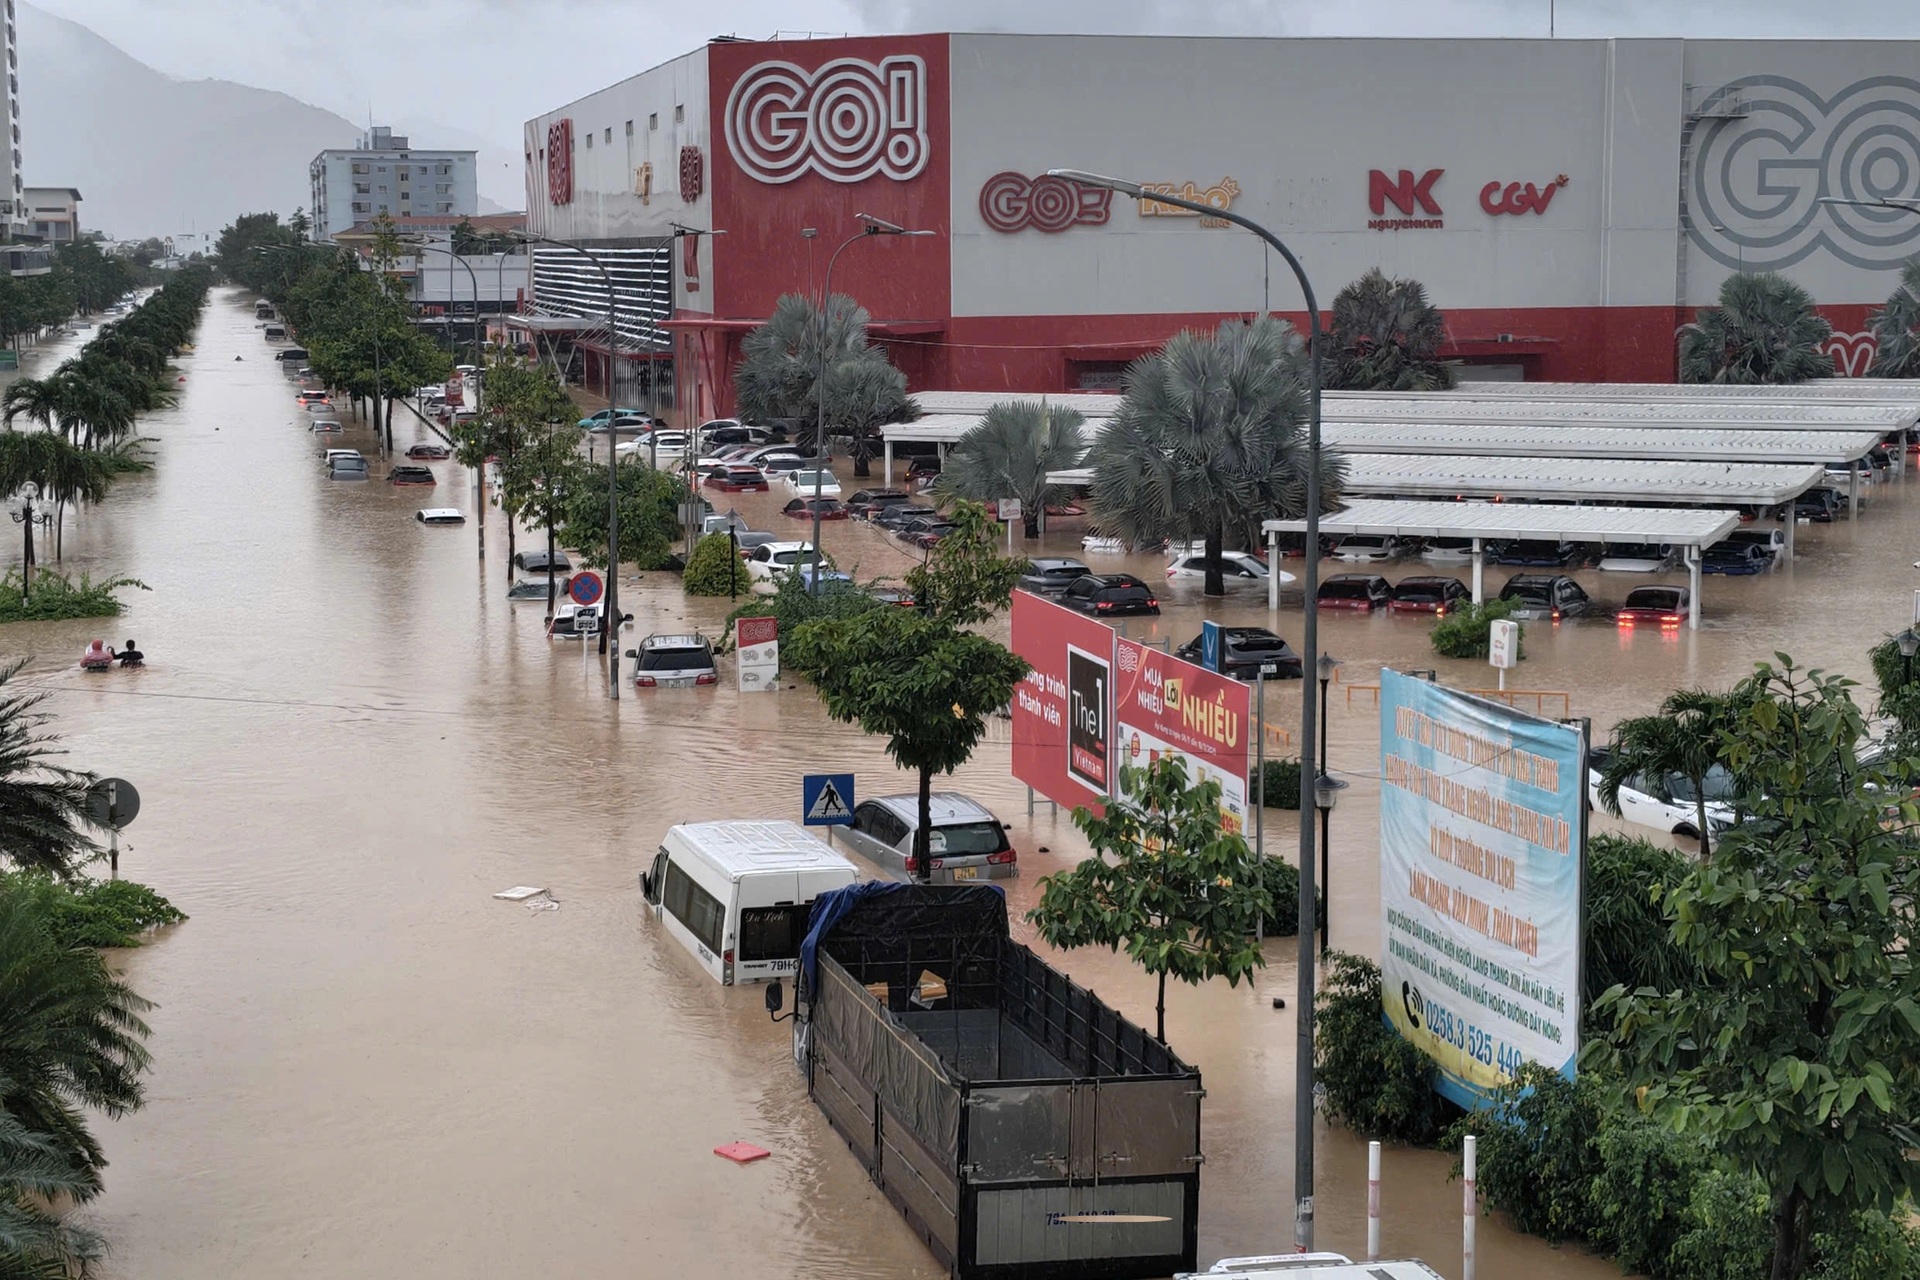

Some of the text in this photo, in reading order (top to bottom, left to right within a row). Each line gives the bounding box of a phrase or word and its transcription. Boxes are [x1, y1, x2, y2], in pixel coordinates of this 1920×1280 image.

[724, 54, 930, 184] GO!
[1369, 169, 1445, 215] NK
[1480, 181, 1557, 216] CGV
[1144, 666, 1163, 689] MUA
[1019, 688, 1061, 728] thành viên
[1182, 688, 1238, 748] NHIỀU
[1075, 750, 1102, 778] Vietnam
[1490, 961, 1509, 986] THANG
[1427, 1000, 1464, 1049] 0258.3
[1469, 1025, 1492, 1066] 525
